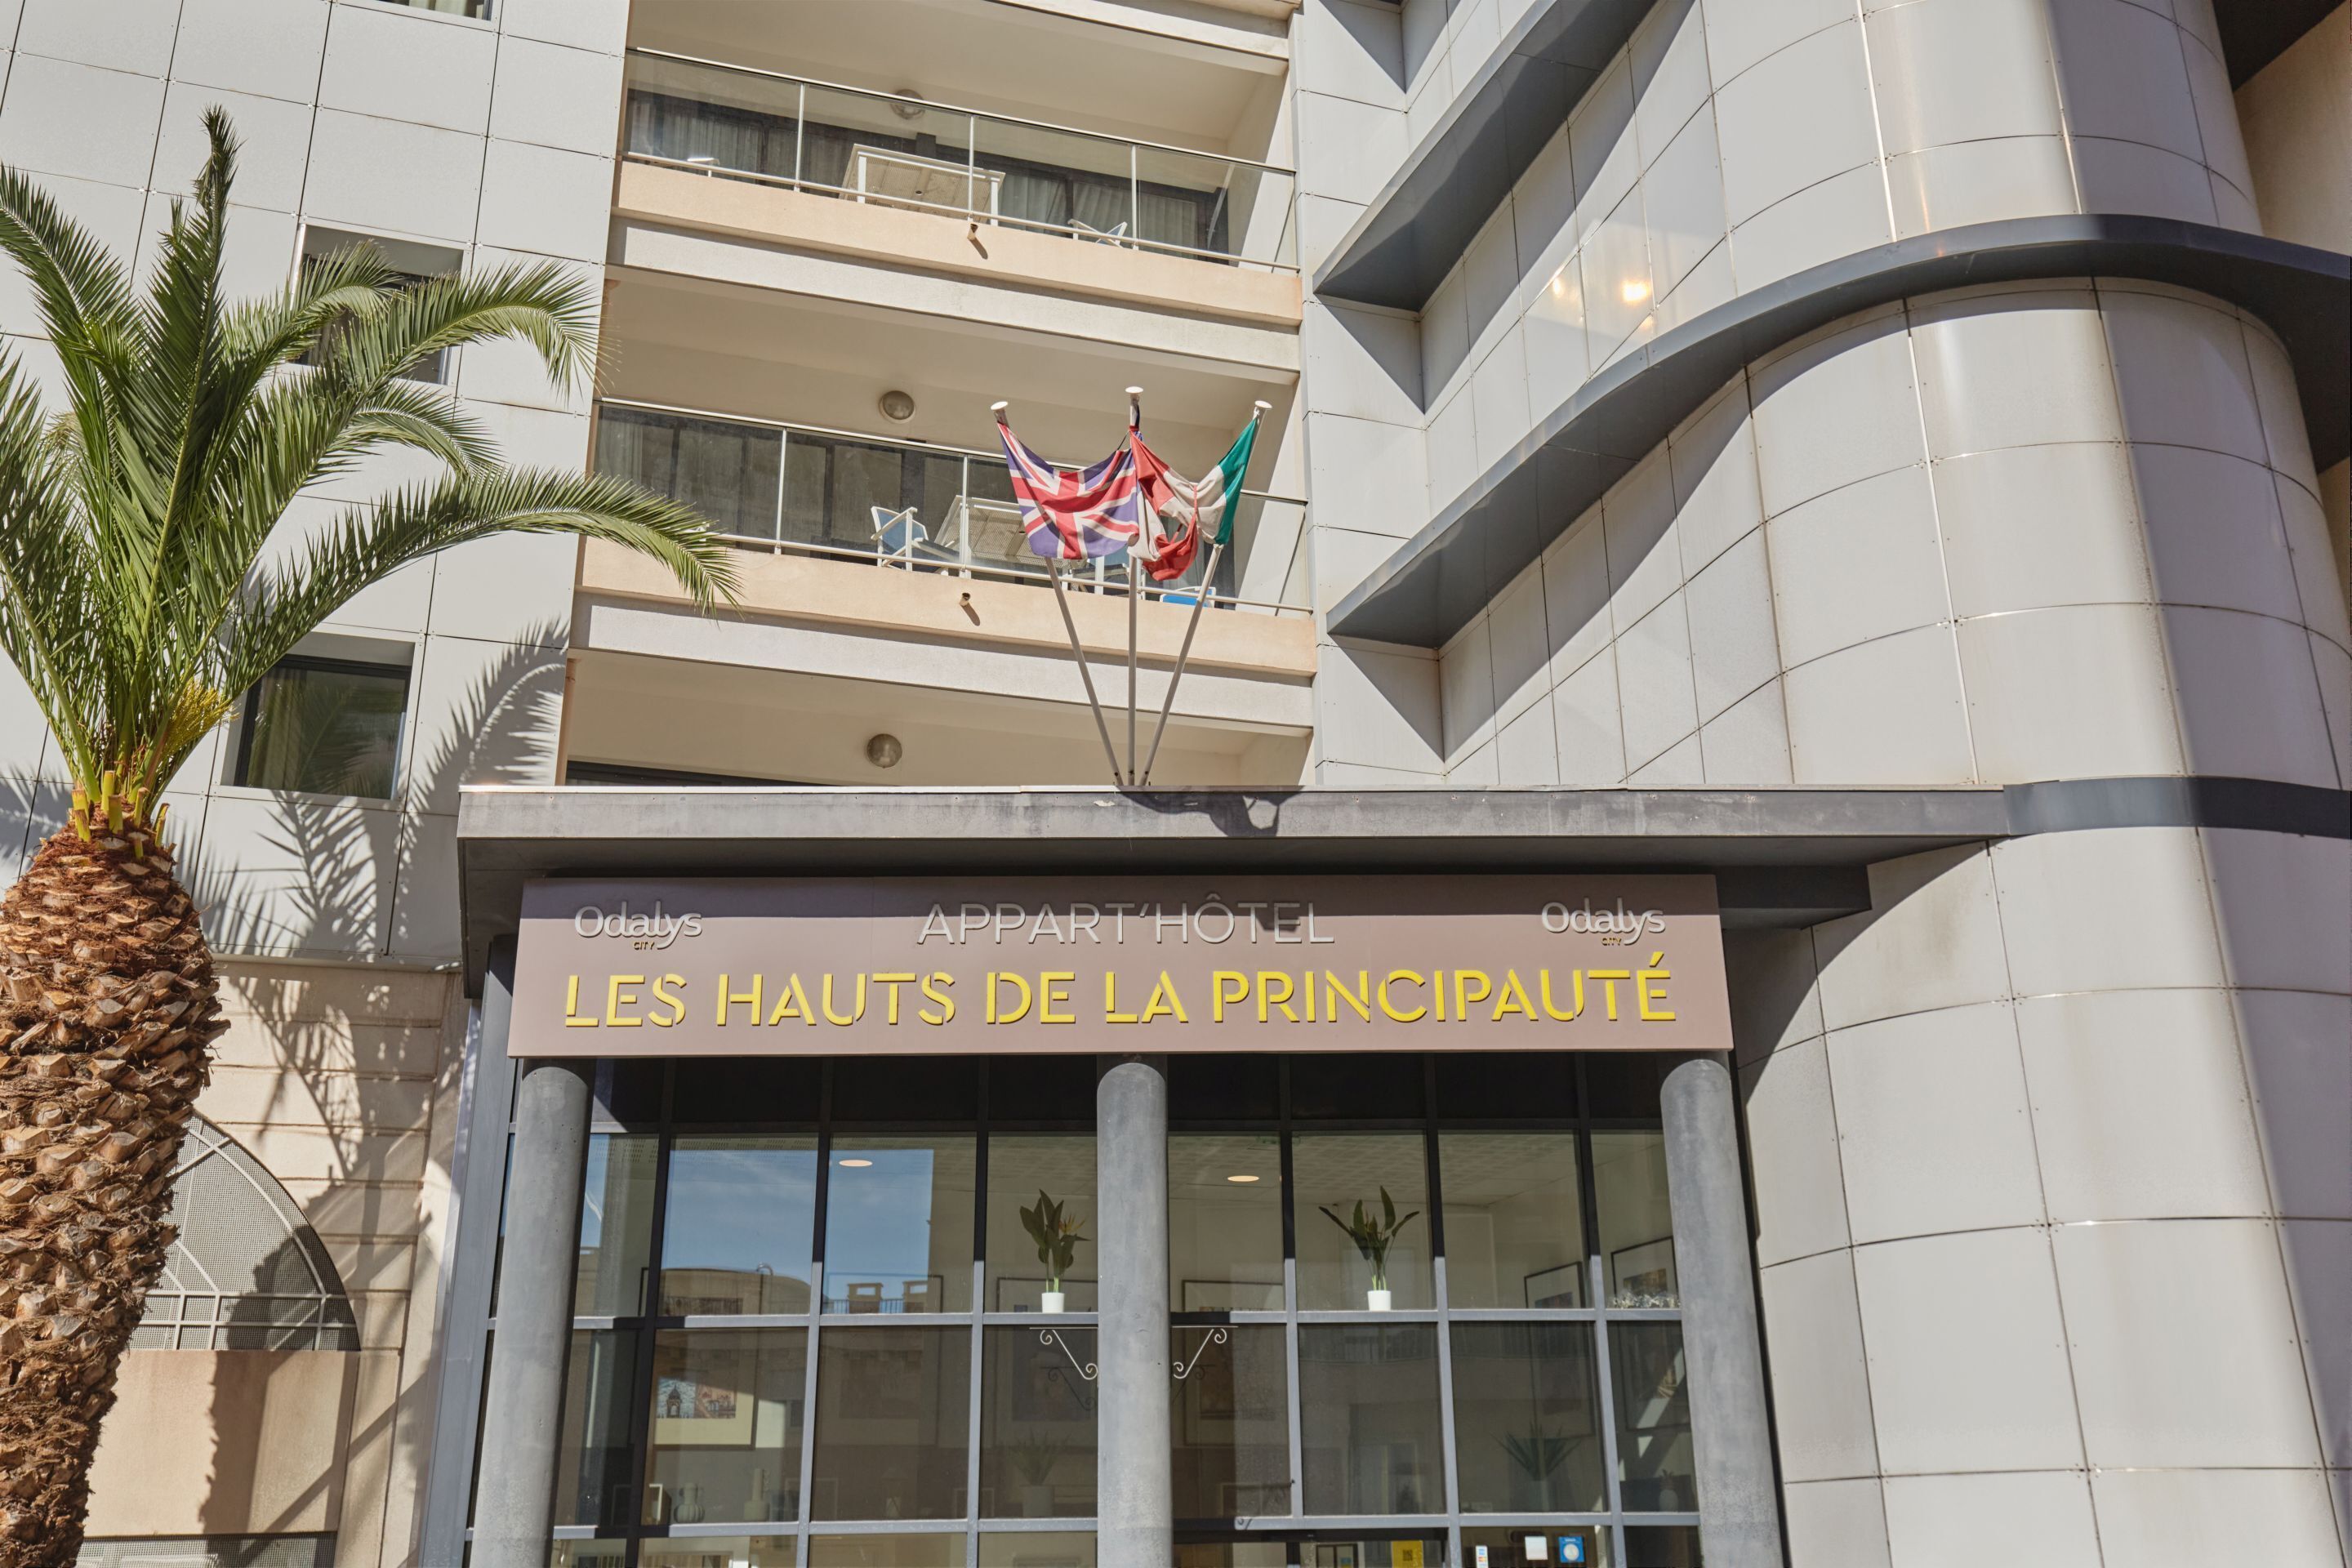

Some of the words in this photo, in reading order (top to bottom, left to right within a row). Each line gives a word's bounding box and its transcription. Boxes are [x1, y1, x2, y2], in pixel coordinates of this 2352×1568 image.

[575, 901, 702, 950] Odalys
[1542, 898, 1666, 945] Odalys
[633, 941, 655, 951] CITY
[565, 973, 687, 1027] LES
[716, 972, 956, 1027] HAUTS
[986, 971, 1076, 1025] DE
[1105, 970, 1189, 1023] LA
[1212, 951, 1677, 1023] PRINCIPAUTÉ
